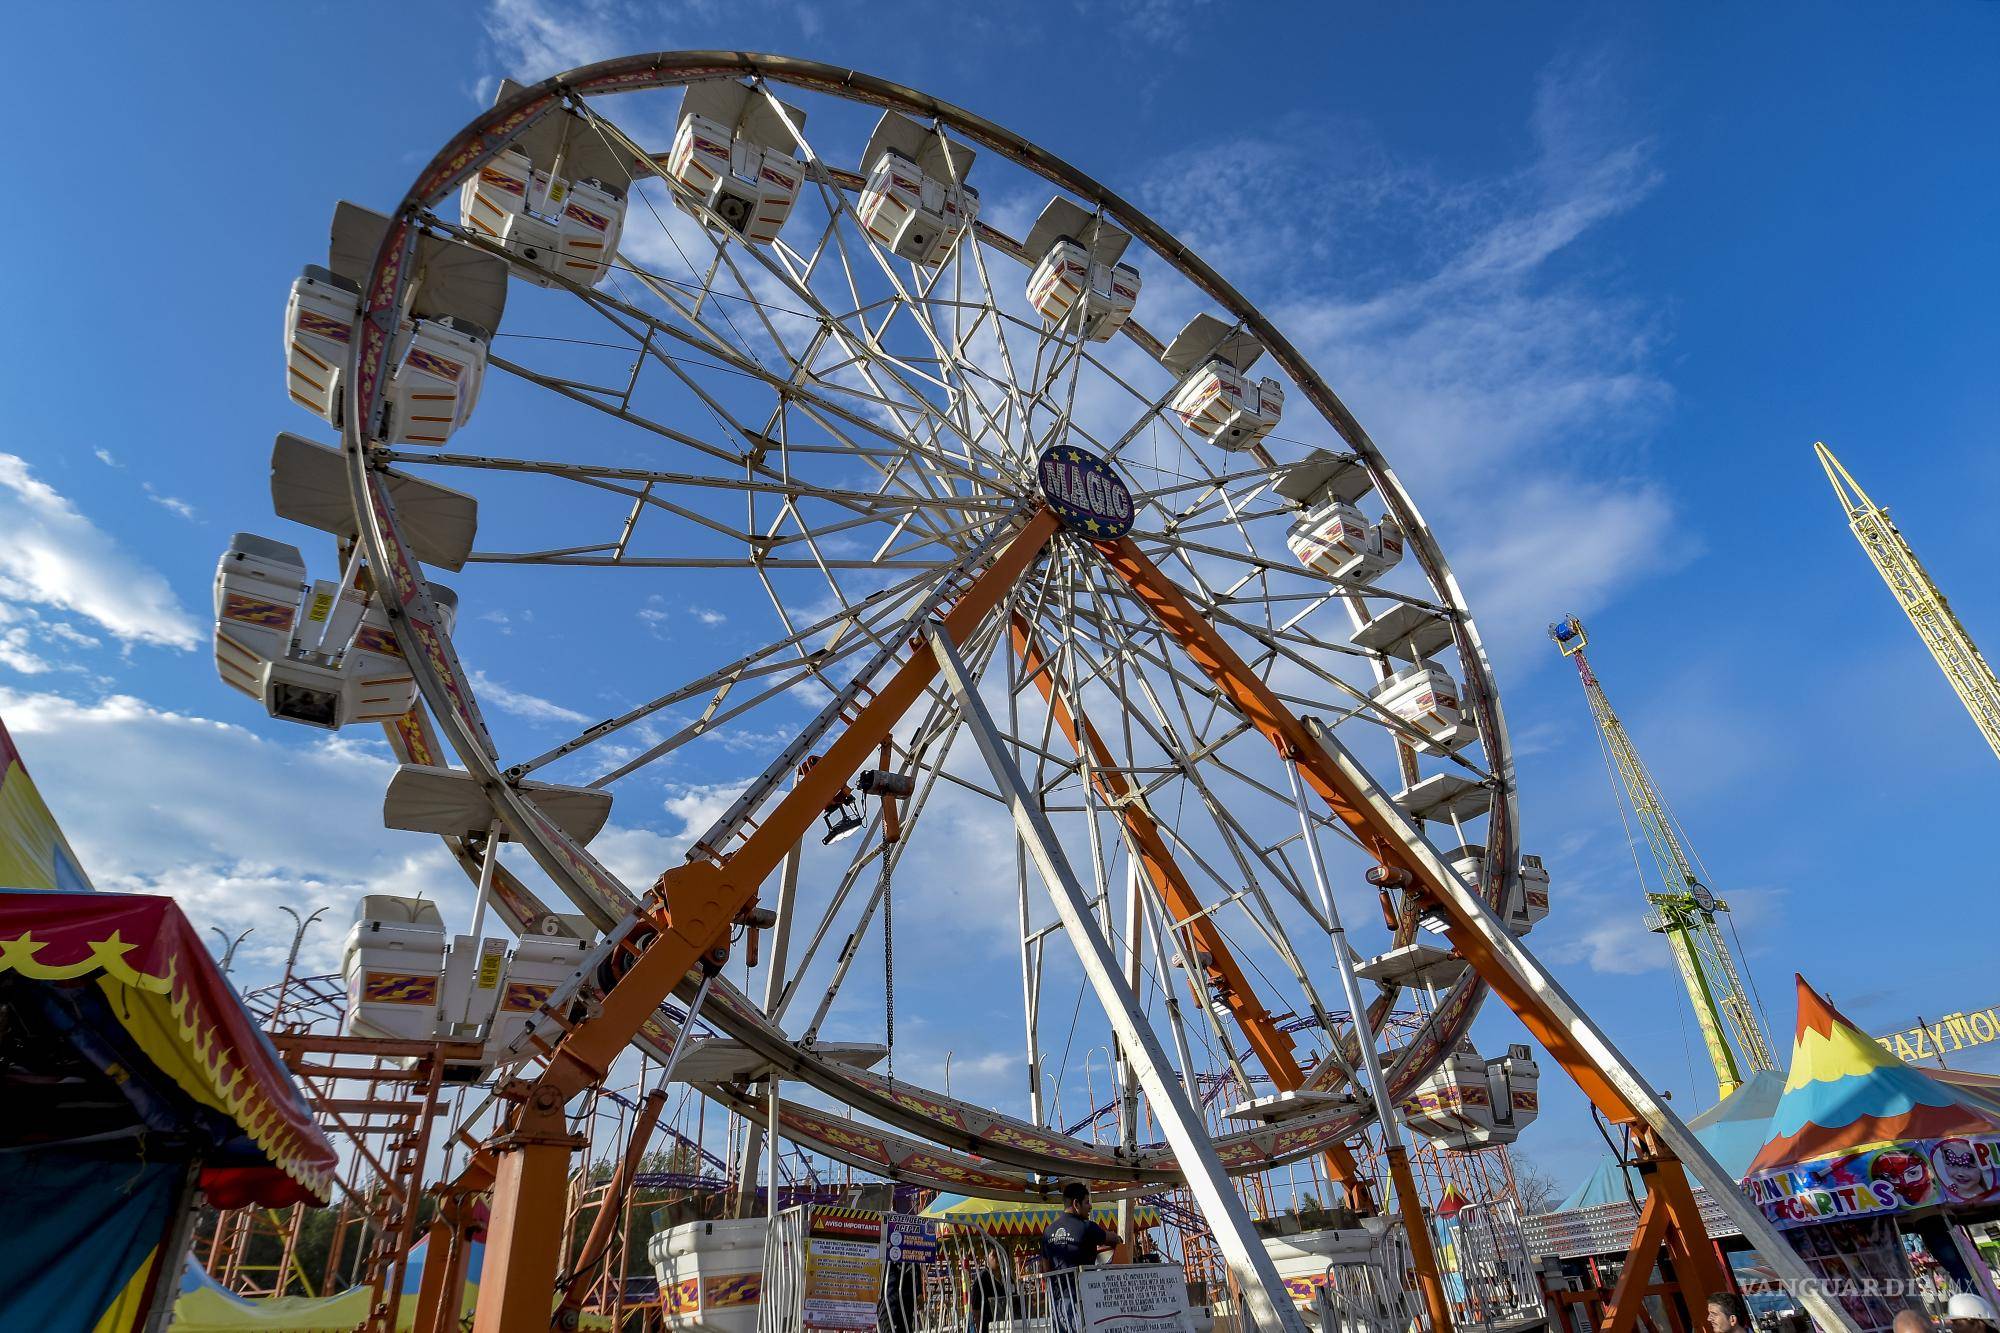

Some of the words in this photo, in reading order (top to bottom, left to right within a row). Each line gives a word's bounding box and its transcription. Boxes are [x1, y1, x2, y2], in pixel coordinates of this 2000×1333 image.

[591, 178, 602, 190] 3
[438, 316, 454, 328] 4
[1044, 462, 1128, 518] MAGIC
[542, 915, 559, 936] 6
[847, 1189, 863, 1210] 7
[1788, 1180, 1898, 1223] CARITAS
[825, 1220, 843, 1228] AVISO
[844, 1221, 880, 1231] IMPORTANTE
[894, 1224, 920, 1233] ACEPTA
